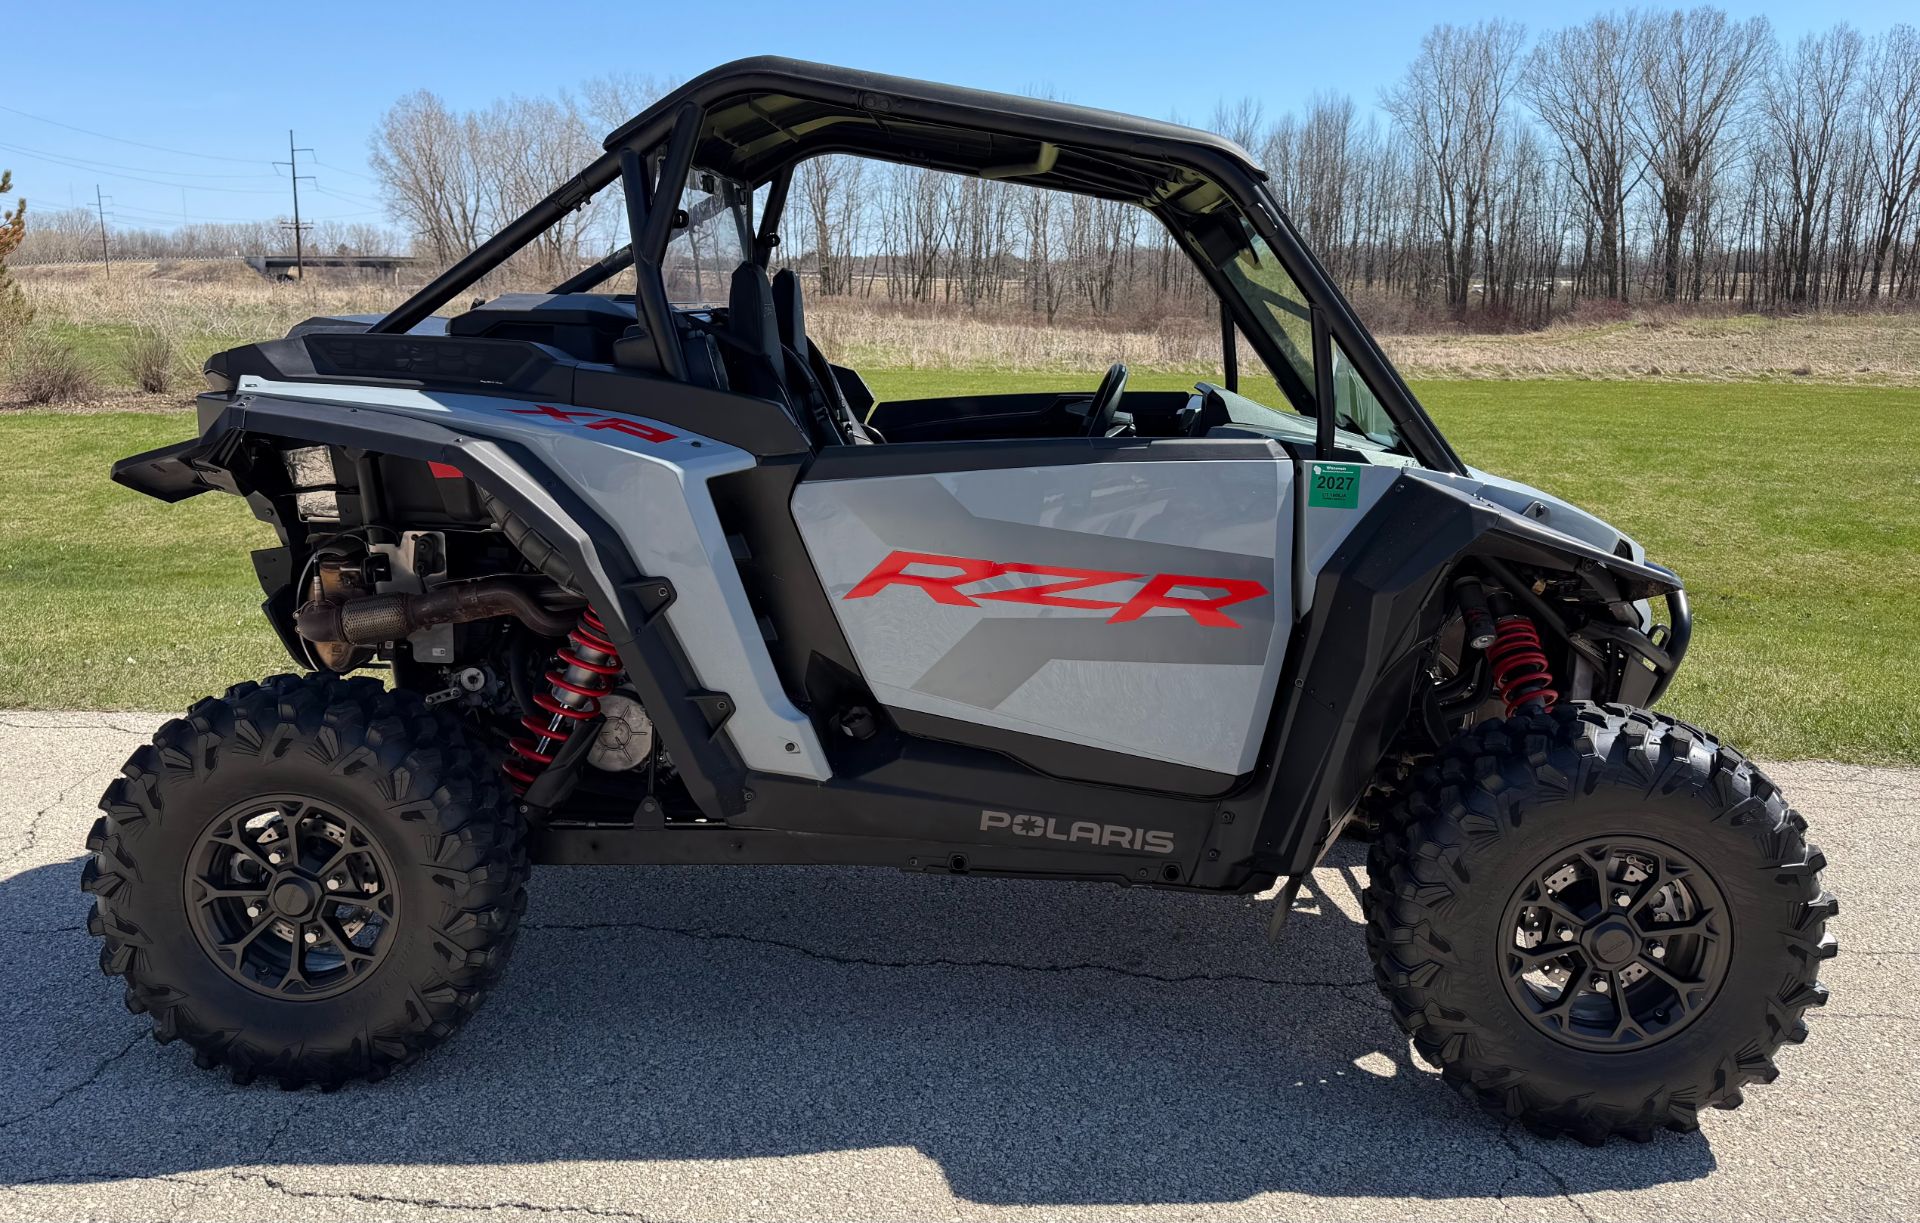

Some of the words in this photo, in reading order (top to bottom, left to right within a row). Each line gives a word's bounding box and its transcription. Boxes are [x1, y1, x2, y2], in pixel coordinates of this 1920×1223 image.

[504, 404, 679, 443] XP
[1316, 475, 1355, 490] 2027
[842, 550, 1269, 629] RZR
[979, 810, 1175, 854] POLARIS
